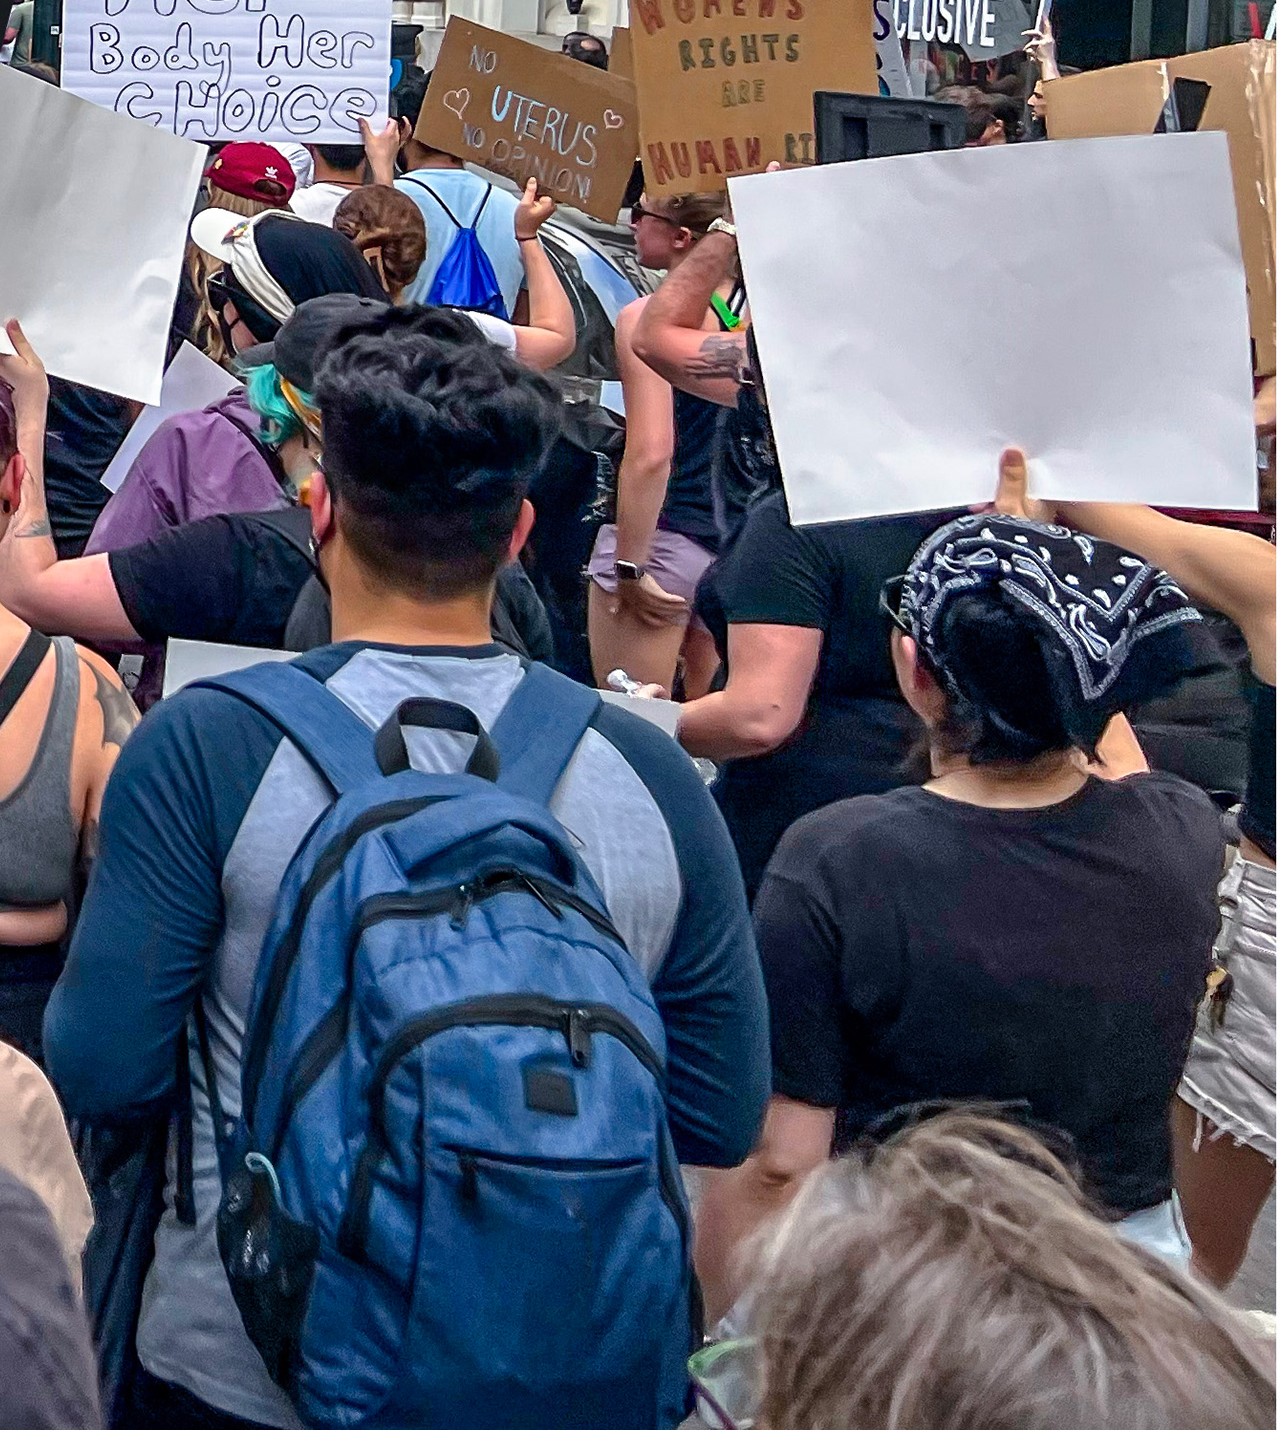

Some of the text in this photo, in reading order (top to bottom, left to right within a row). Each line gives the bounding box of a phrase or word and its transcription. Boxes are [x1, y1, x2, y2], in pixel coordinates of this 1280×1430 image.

[90, 14, 375, 99] Body Her
[469, 45, 498, 74] NO
[678, 33, 801, 72] RIGHTS
[721, 78, 766, 108] ARE
[462, 122, 486, 149] NO
[491, 84, 599, 168] UTERUS
[647, 136, 762, 186] HUMAN
